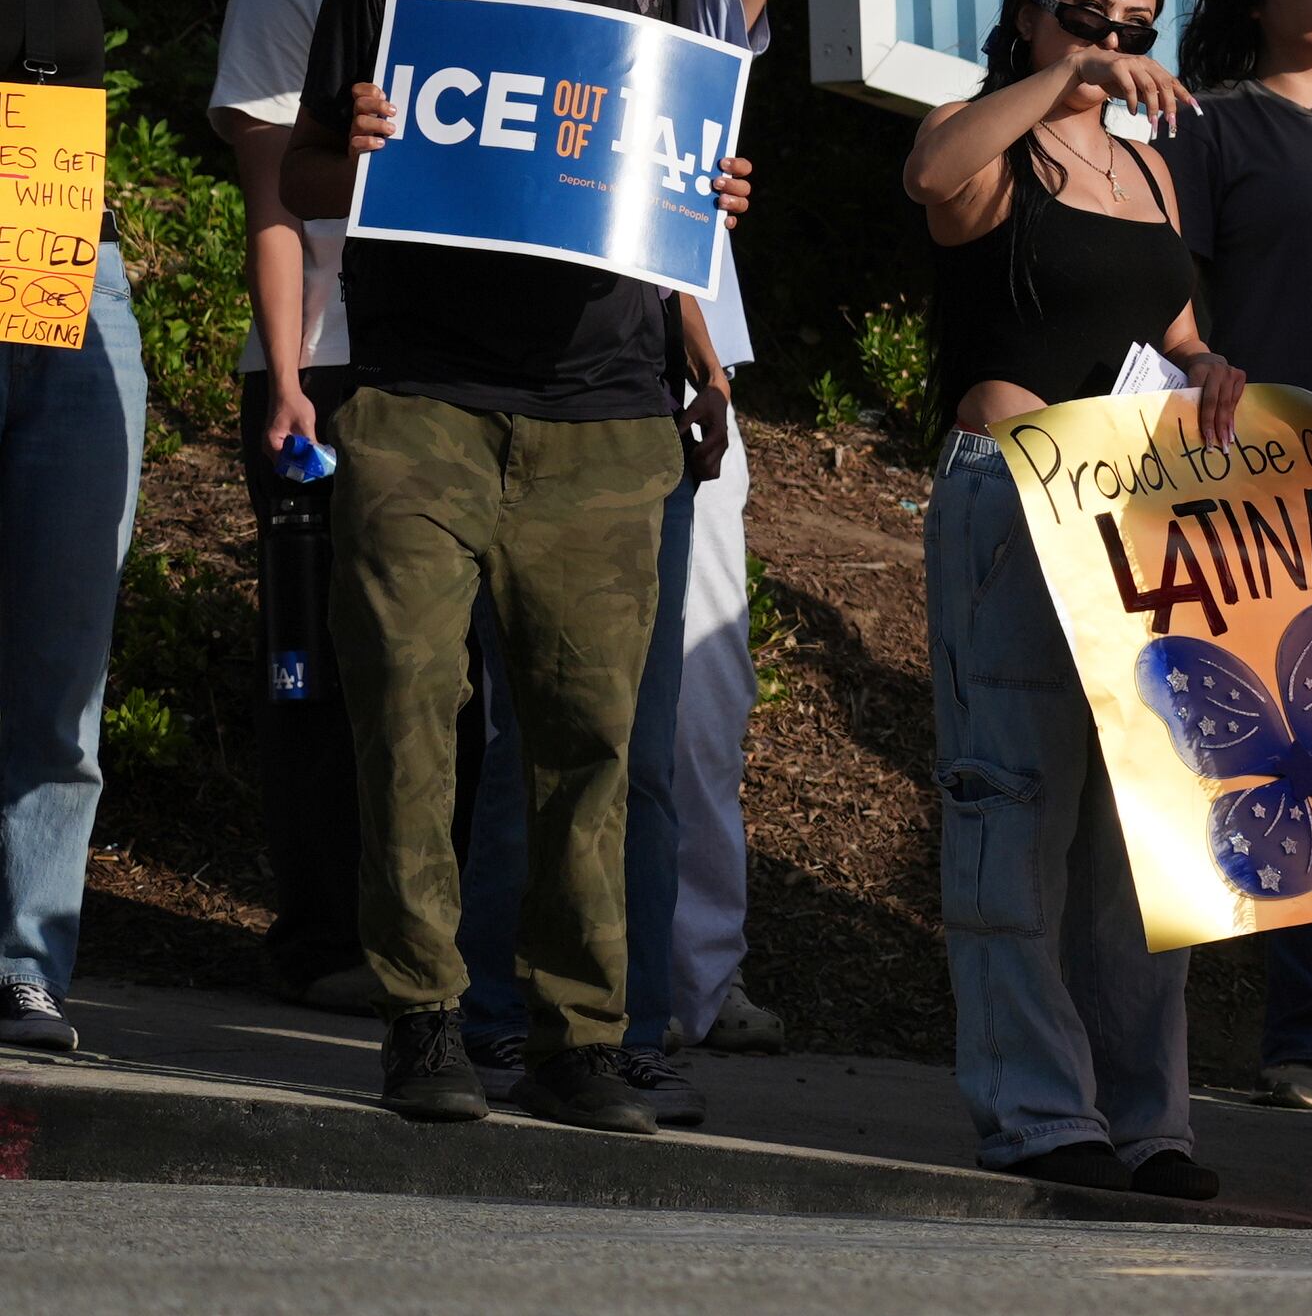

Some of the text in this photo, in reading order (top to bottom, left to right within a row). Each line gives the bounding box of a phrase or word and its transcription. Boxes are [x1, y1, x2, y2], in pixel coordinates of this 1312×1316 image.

[388, 64, 546, 151] ICE
[553, 79, 608, 123] OUT
[54, 148, 106, 172] GET
[555, 120, 593, 160] OF
[16, 181, 93, 212] WHICH
[559, 173, 595, 189] Deport
[662, 199, 677, 212] the
[679, 204, 710, 224] People
[1010, 410, 1176, 524] Proud
[1180, 417, 1229, 481] to
[1236, 432, 1296, 476] be
